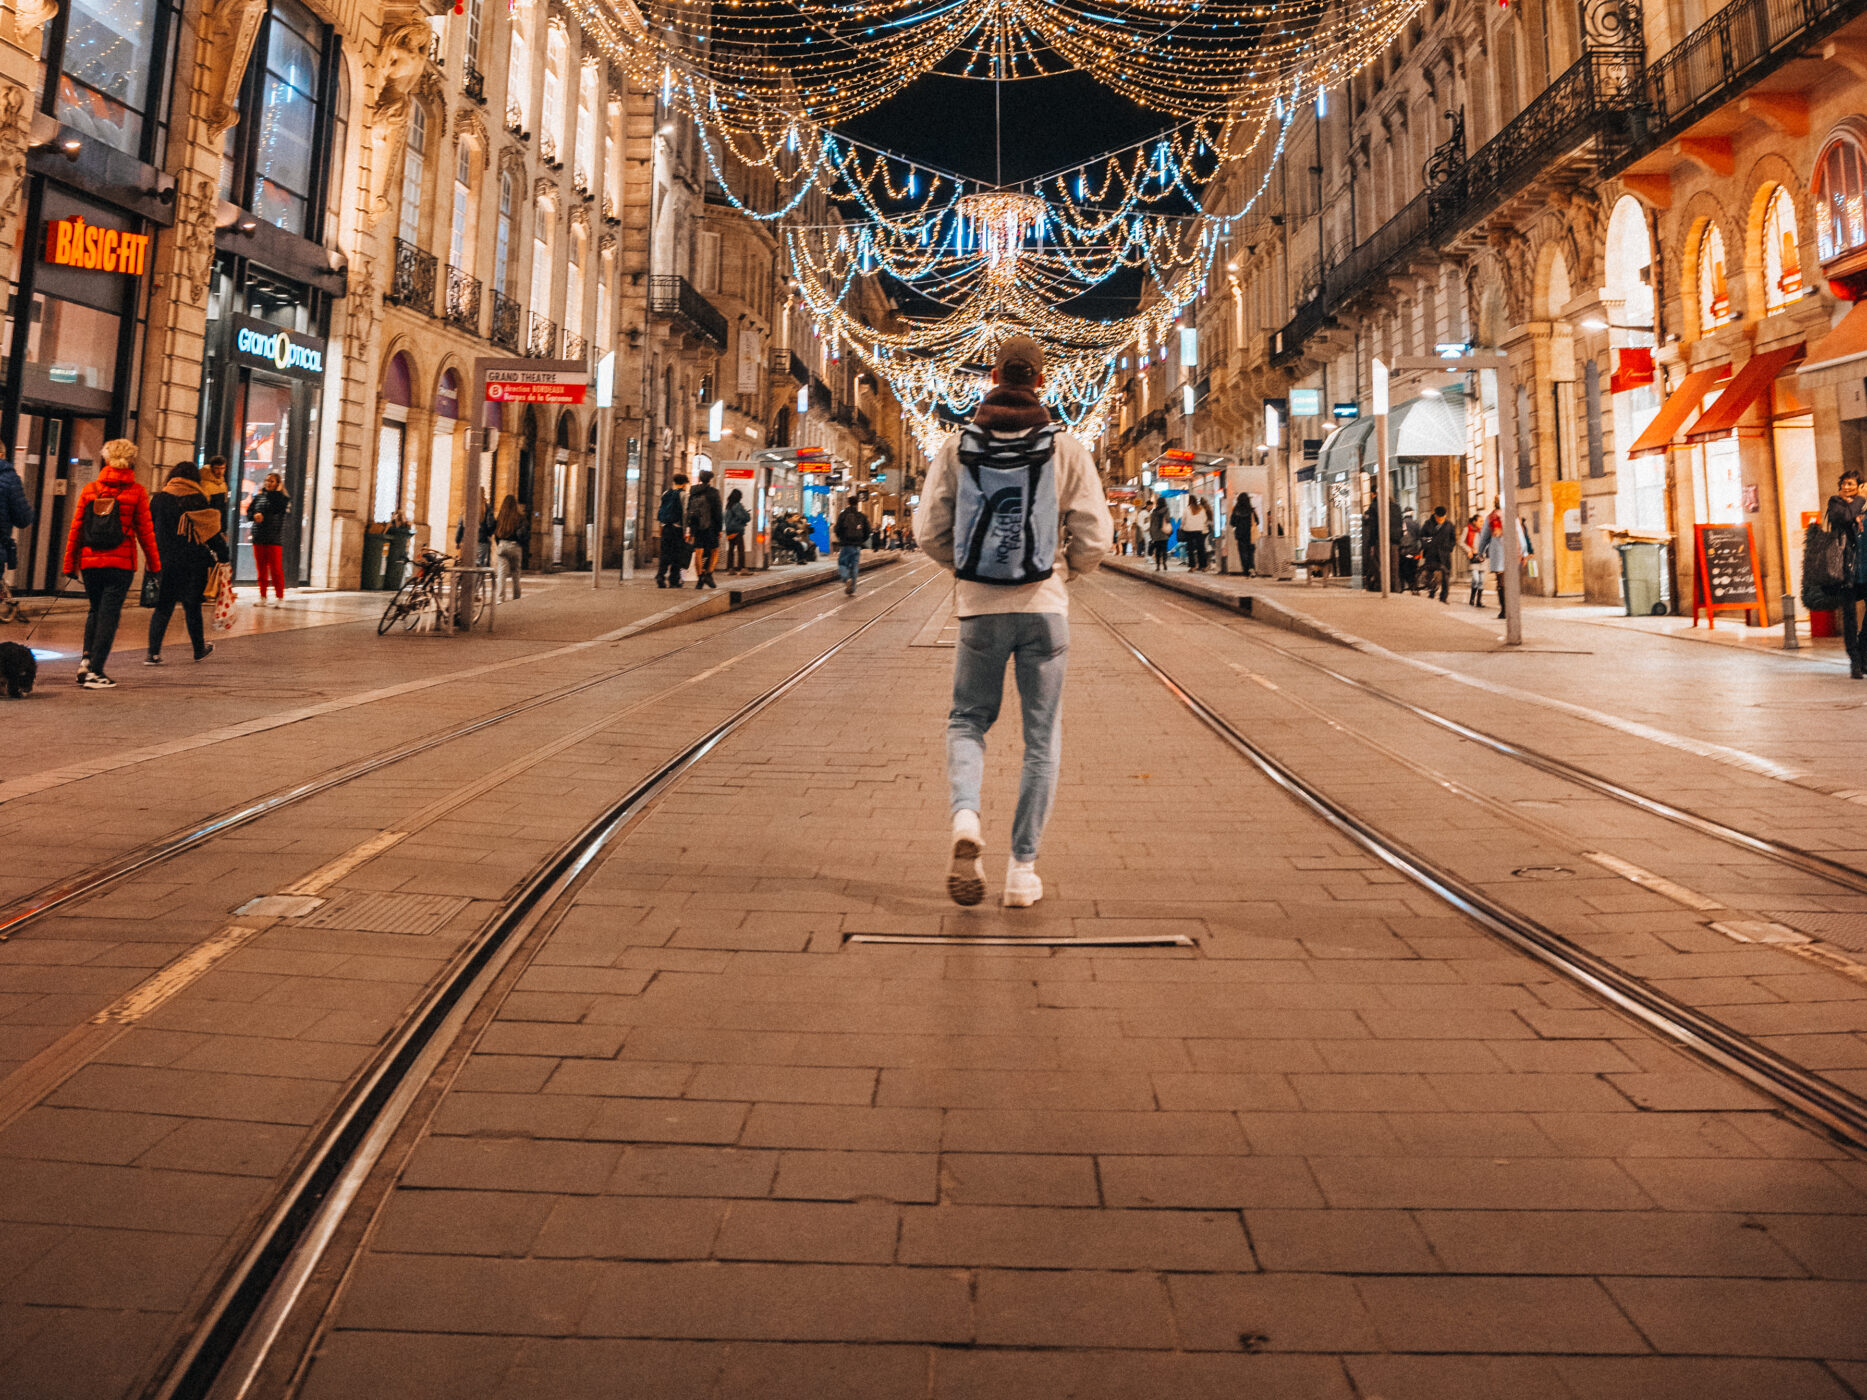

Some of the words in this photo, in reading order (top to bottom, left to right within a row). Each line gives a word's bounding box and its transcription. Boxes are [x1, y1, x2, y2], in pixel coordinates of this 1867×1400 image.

[488, 372, 518, 381] GRAND
[521, 373, 556, 383] THEATRE
[1009, 514, 1022, 551] FACE
